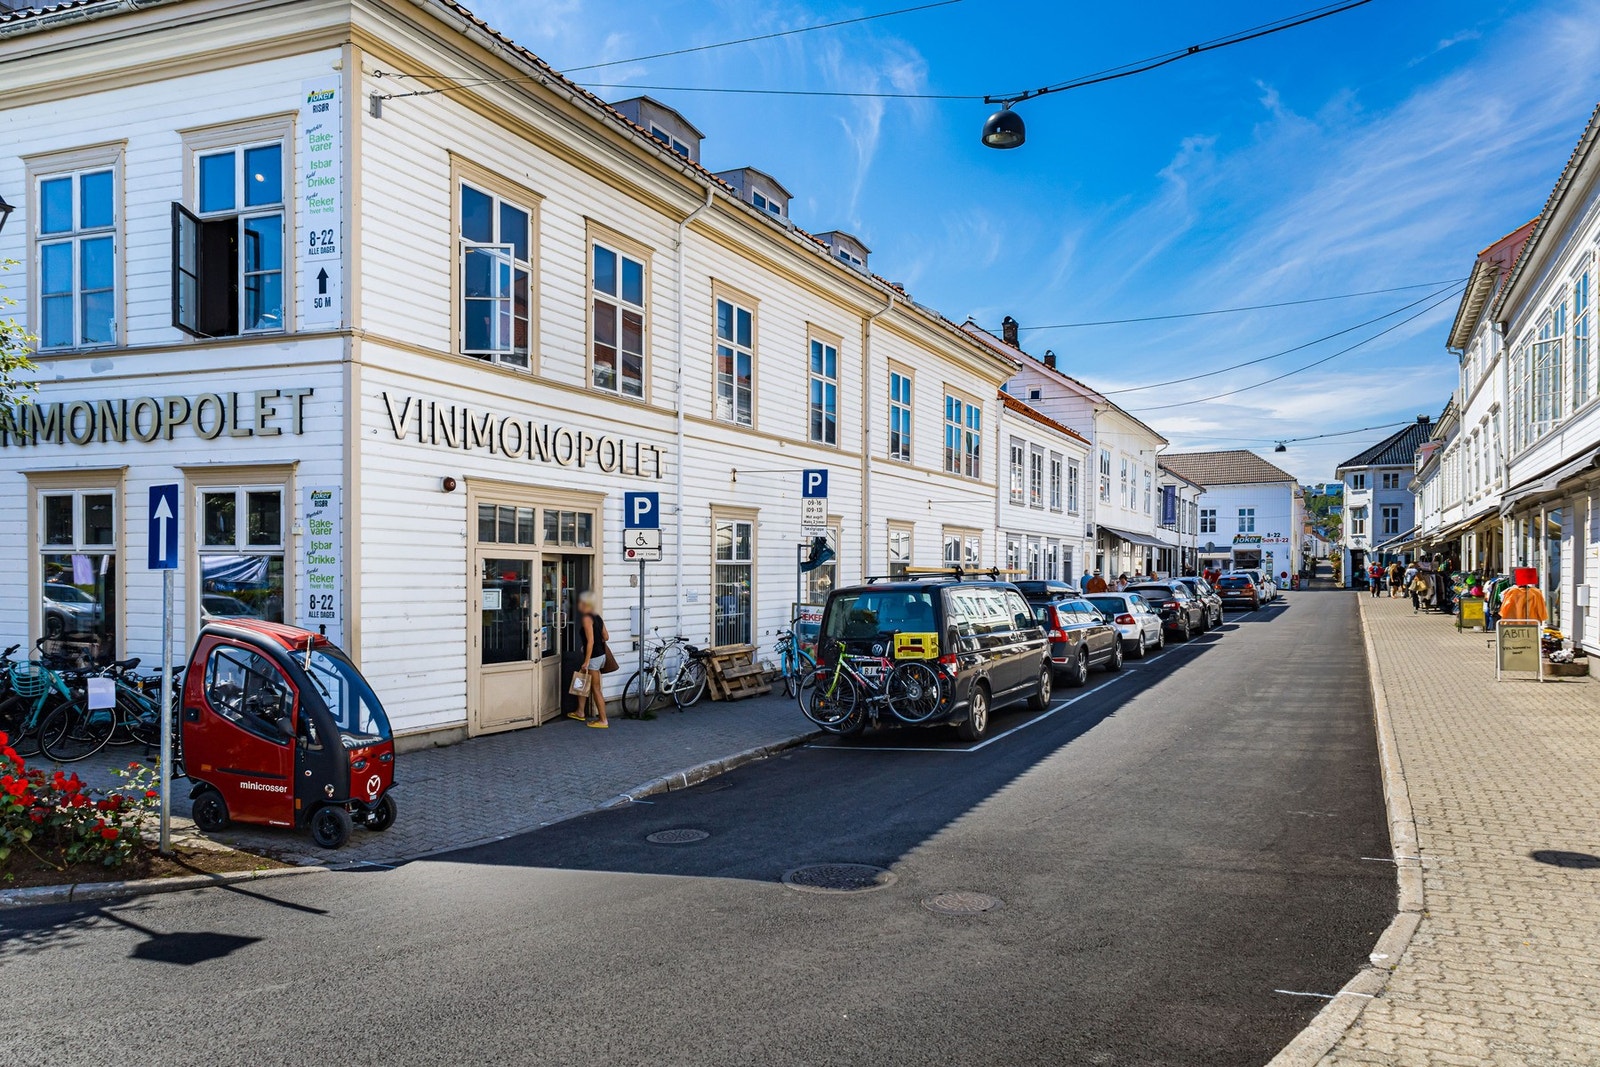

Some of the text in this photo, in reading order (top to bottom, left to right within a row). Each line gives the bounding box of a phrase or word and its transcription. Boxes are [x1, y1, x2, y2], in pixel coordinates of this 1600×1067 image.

[309, 134, 334, 144] Bake-
[310, 142, 332, 152] varer
[310, 160, 332, 170] Isbar
[308, 176, 336, 188] Drikke
[309, 198, 334, 208] Reker
[310, 229, 334, 246] 8-22
[314, 296, 331, 308] 50 M
[382, 391, 668, 478] VINMONOPOLET
[808, 472, 822, 494] P
[634, 497, 652, 524] P
[310, 519, 334, 528] Bake-
[310, 528, 332, 536] varer
[310, 541, 332, 550] Isbar
[308, 555, 336, 564] Drikke
[310, 574, 334, 582] Reker
[310, 594, 334, 610] 8-22
[1502, 629, 1530, 638] ABITI
[240, 781, 288, 793] minicrosser
